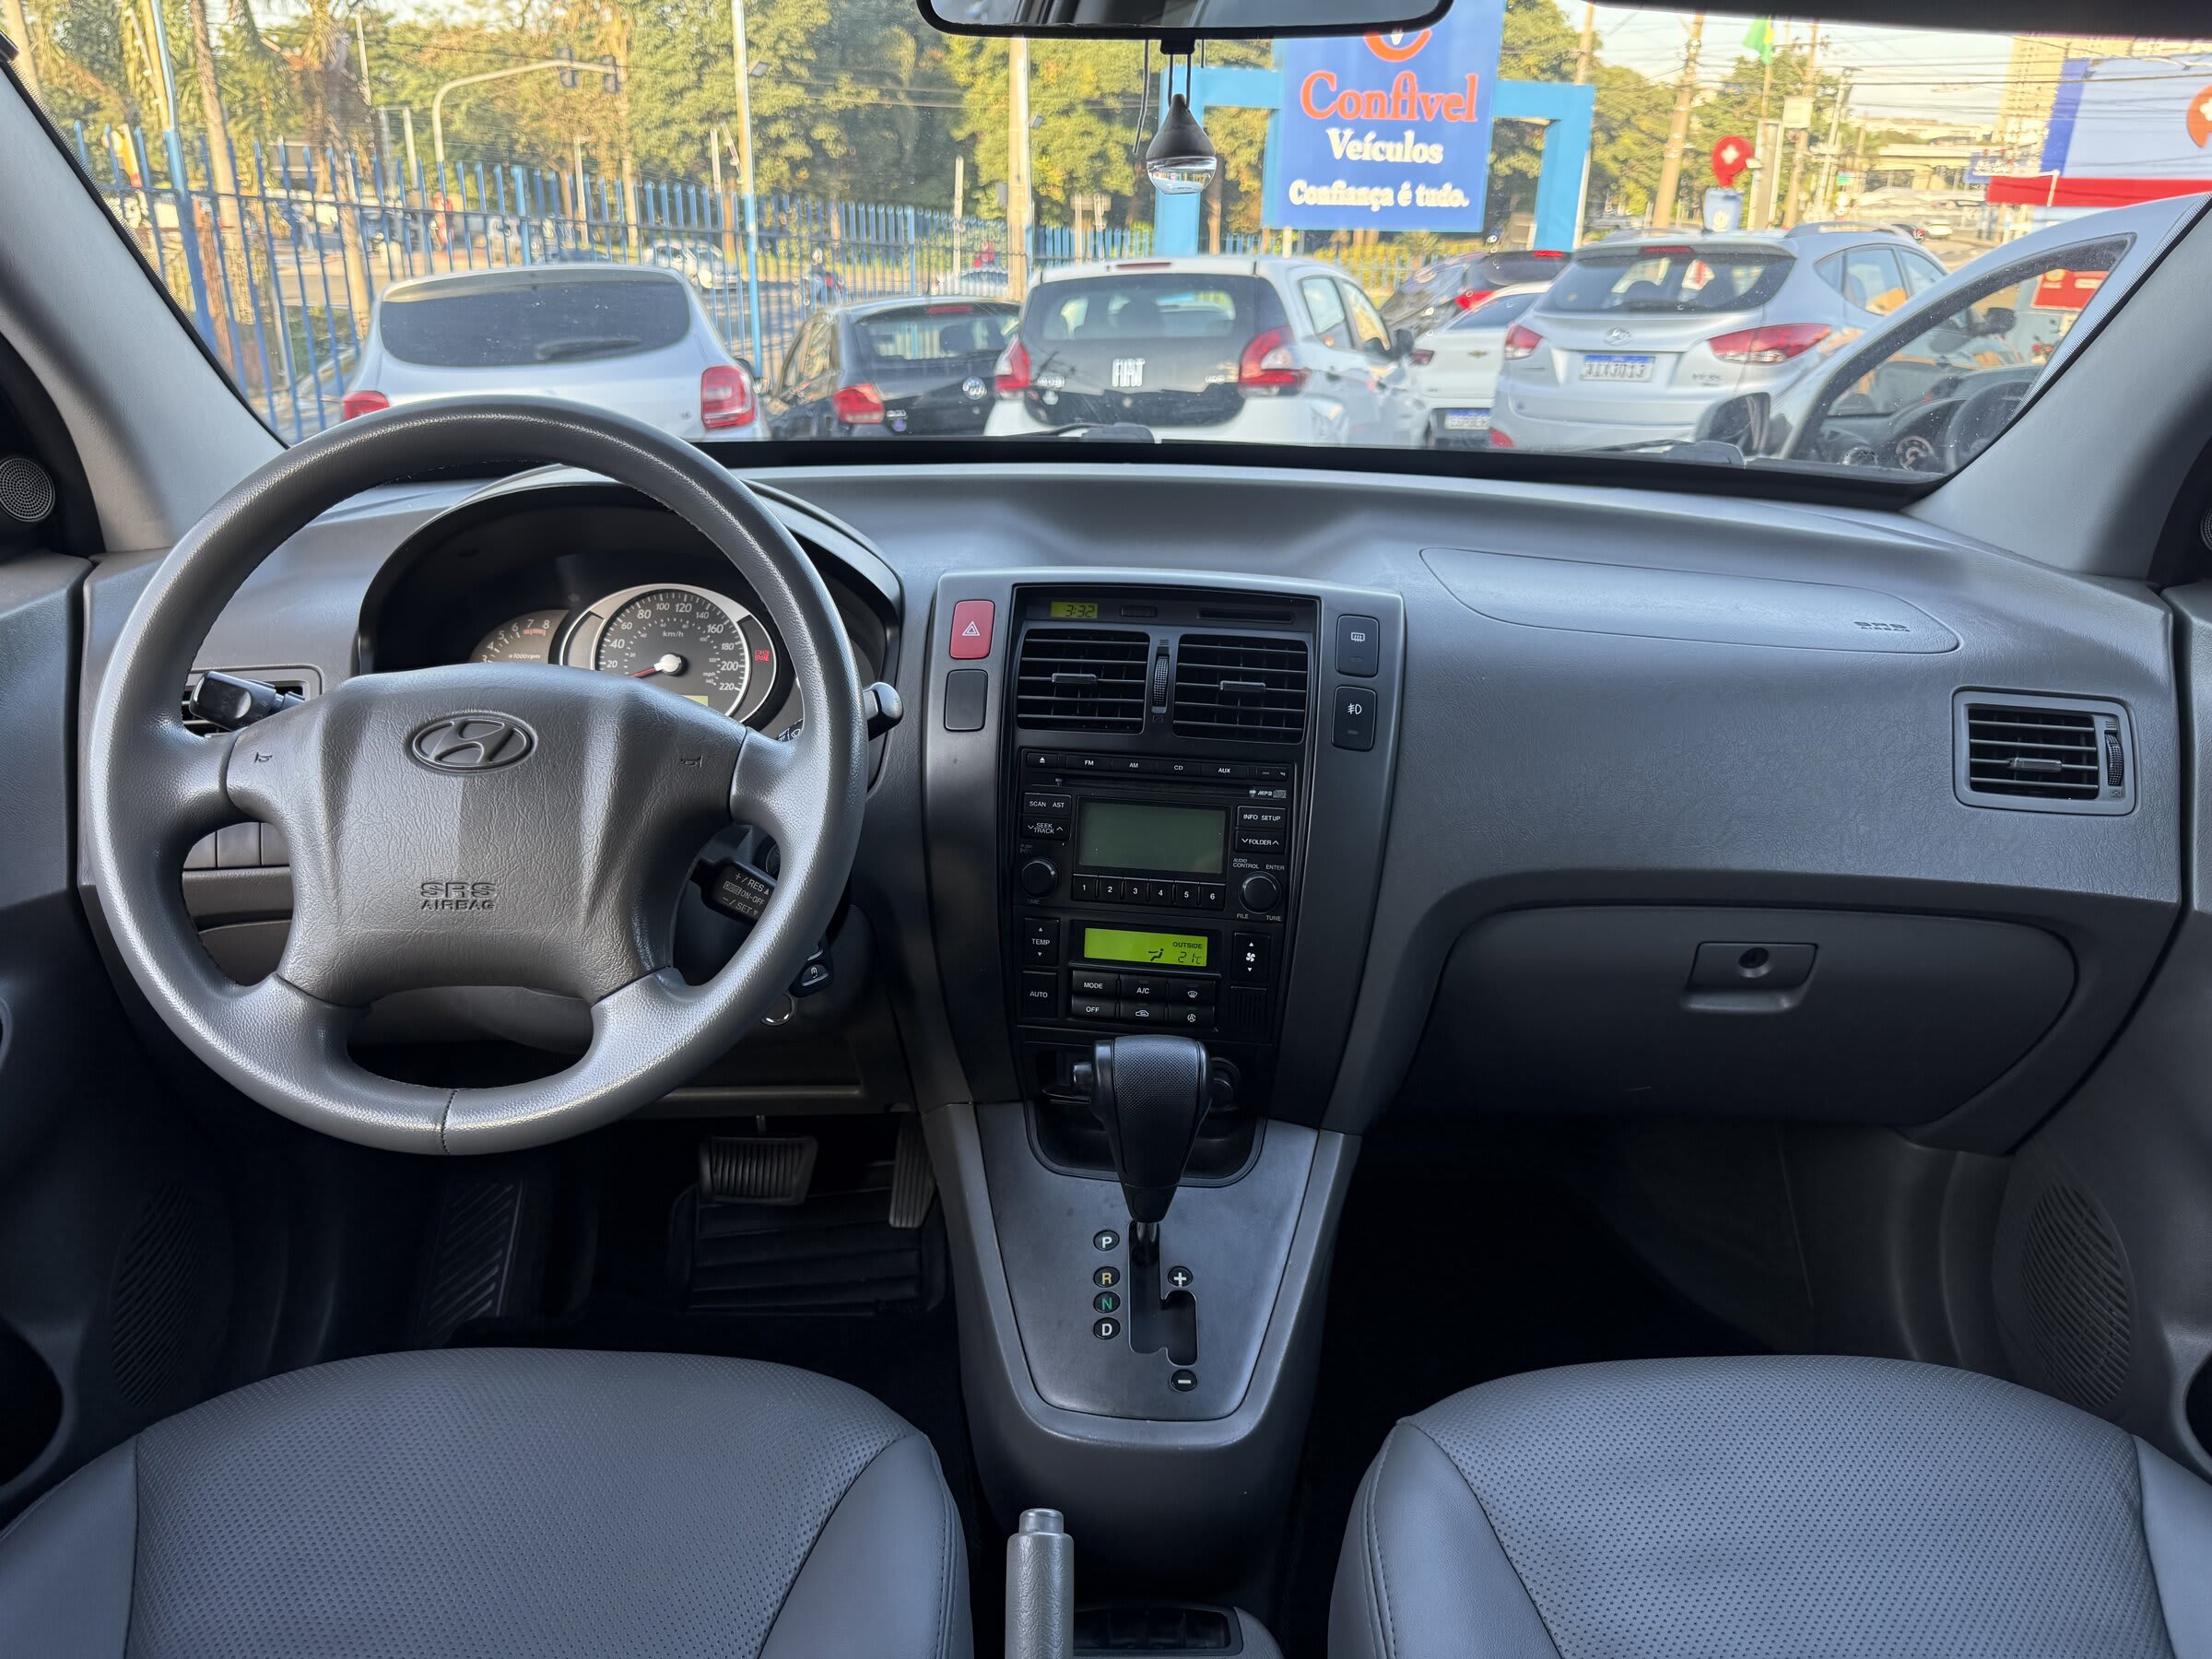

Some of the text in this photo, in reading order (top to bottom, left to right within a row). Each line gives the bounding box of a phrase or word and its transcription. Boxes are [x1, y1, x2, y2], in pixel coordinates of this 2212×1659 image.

[1325, 127, 1443, 164] Veículos
[1288, 179, 1470, 212] Confiança é tudo.
[1112, 358, 1146, 387] FIAT
[656, 603, 670, 611] 100
[676, 603, 691, 613] 120
[1065, 605, 1096, 618] 3:32
[637, 609, 652, 619] 80
[512, 623, 519, 632] 6
[528, 619, 535, 628] 7
[543, 619, 550, 629] 8
[621, 622, 633, 630] 60
[707, 624, 724, 634] 160
[498, 630, 505, 640] 5
[610, 639, 625, 649] 40
[721, 642, 735, 651] 180
[606, 660, 618, 668] 20
[721, 661, 738, 671] 200
[719, 683, 735, 691] 220
[421, 883, 495, 898] SRS
[421, 900, 495, 910] AIRBAG
[1102, 1237, 1112, 1248] P
[1102, 1273, 1112, 1285] R
[1102, 1298, 1112, 1310] N
[1102, 1324, 1112, 1336] D
